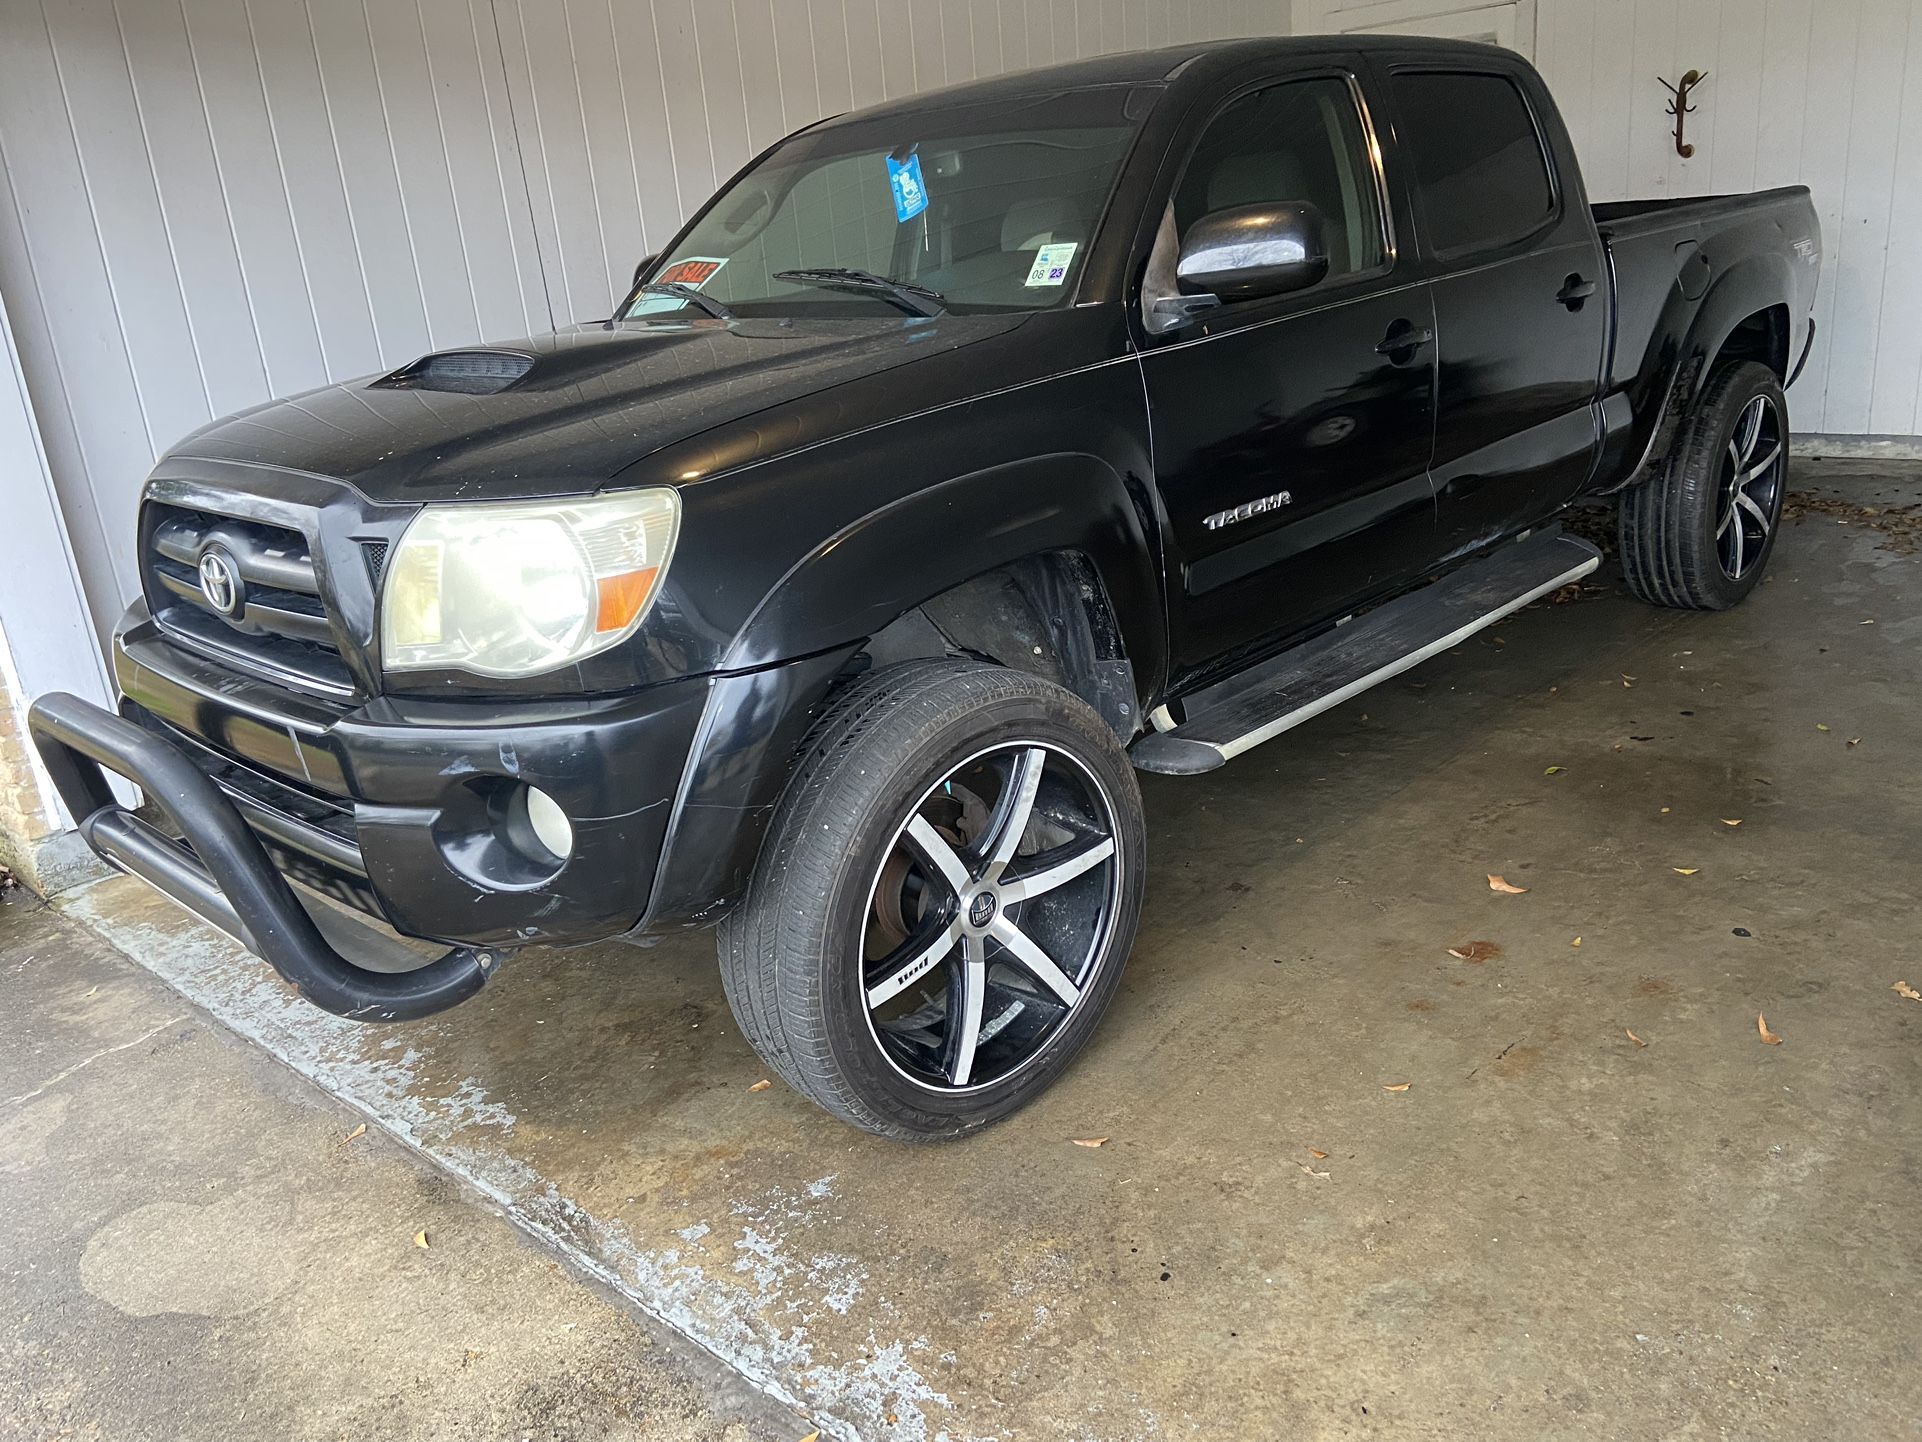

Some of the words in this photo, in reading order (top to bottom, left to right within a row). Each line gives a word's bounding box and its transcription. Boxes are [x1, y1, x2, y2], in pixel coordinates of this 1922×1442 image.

[676, 261, 719, 283] SALE
[1031, 269, 1045, 279] 08
[1050, 268, 1064, 279] 23
[1202, 490, 1292, 530] TACOMA
